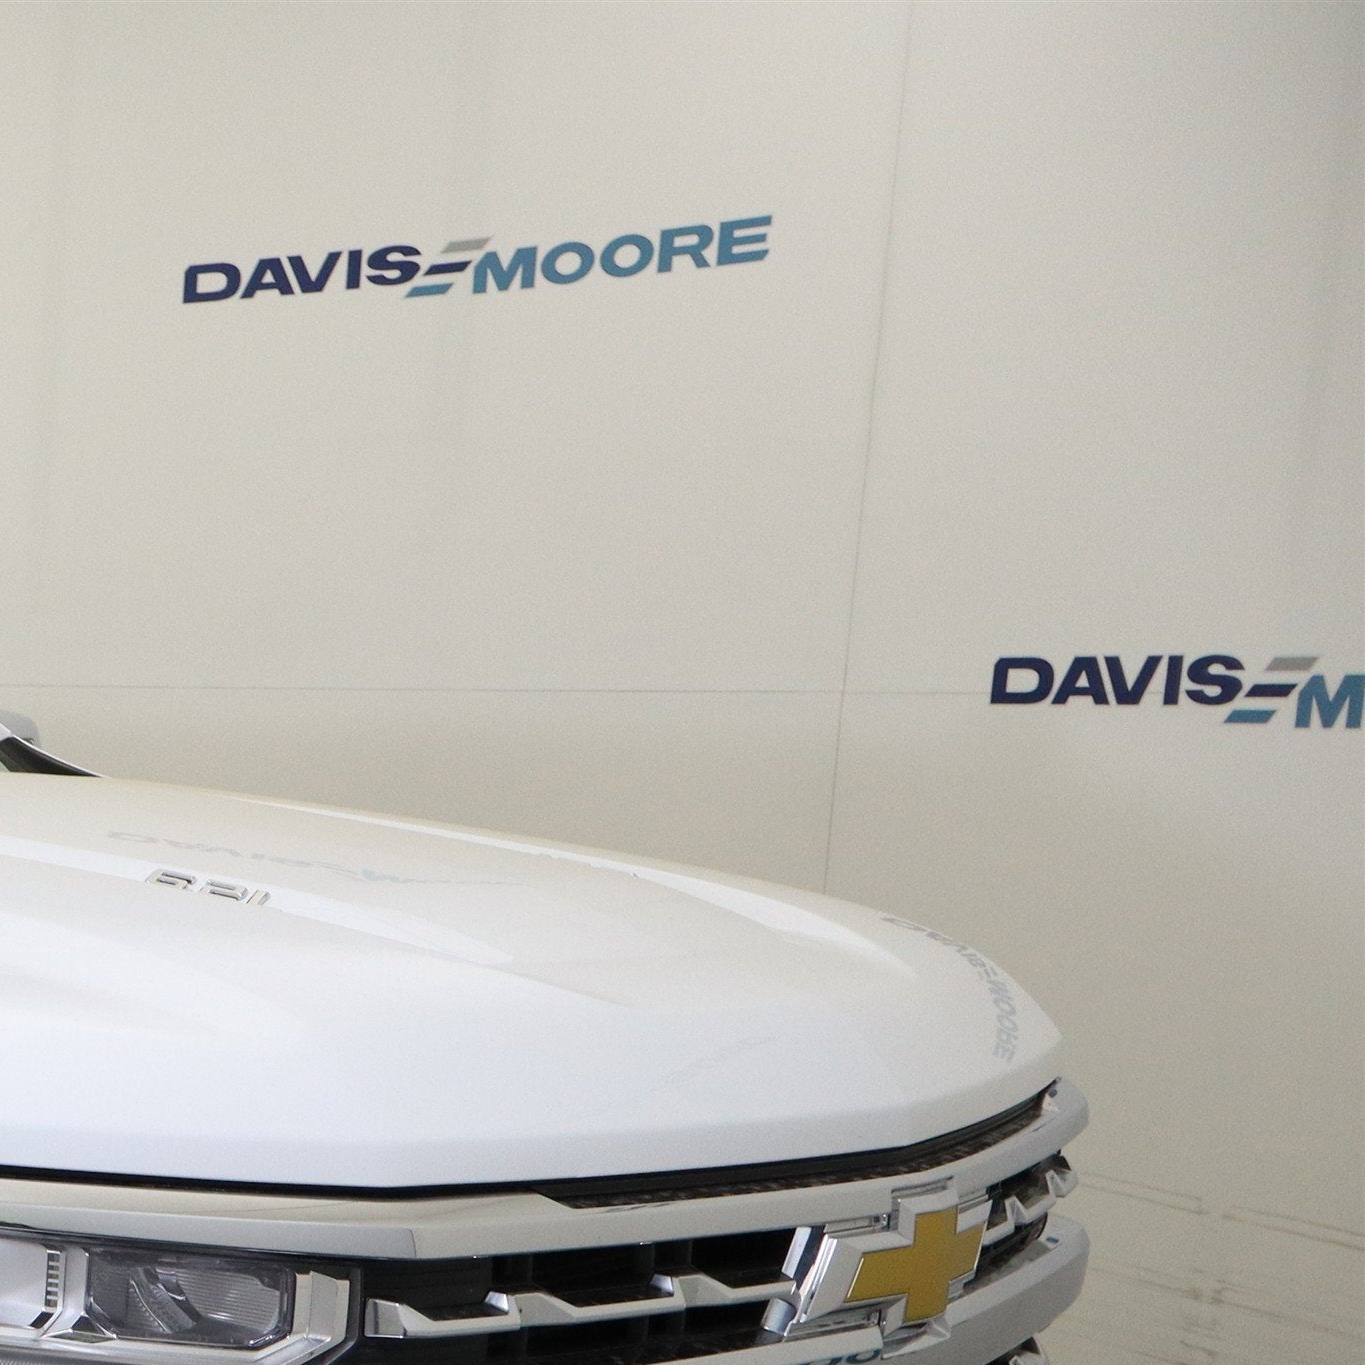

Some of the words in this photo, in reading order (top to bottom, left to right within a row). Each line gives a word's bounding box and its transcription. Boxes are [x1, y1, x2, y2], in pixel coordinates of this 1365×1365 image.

[182, 245, 422, 304] DAVIS
[470, 215, 773, 295] MOORE
[989, 654, 1246, 706] DAVIS
